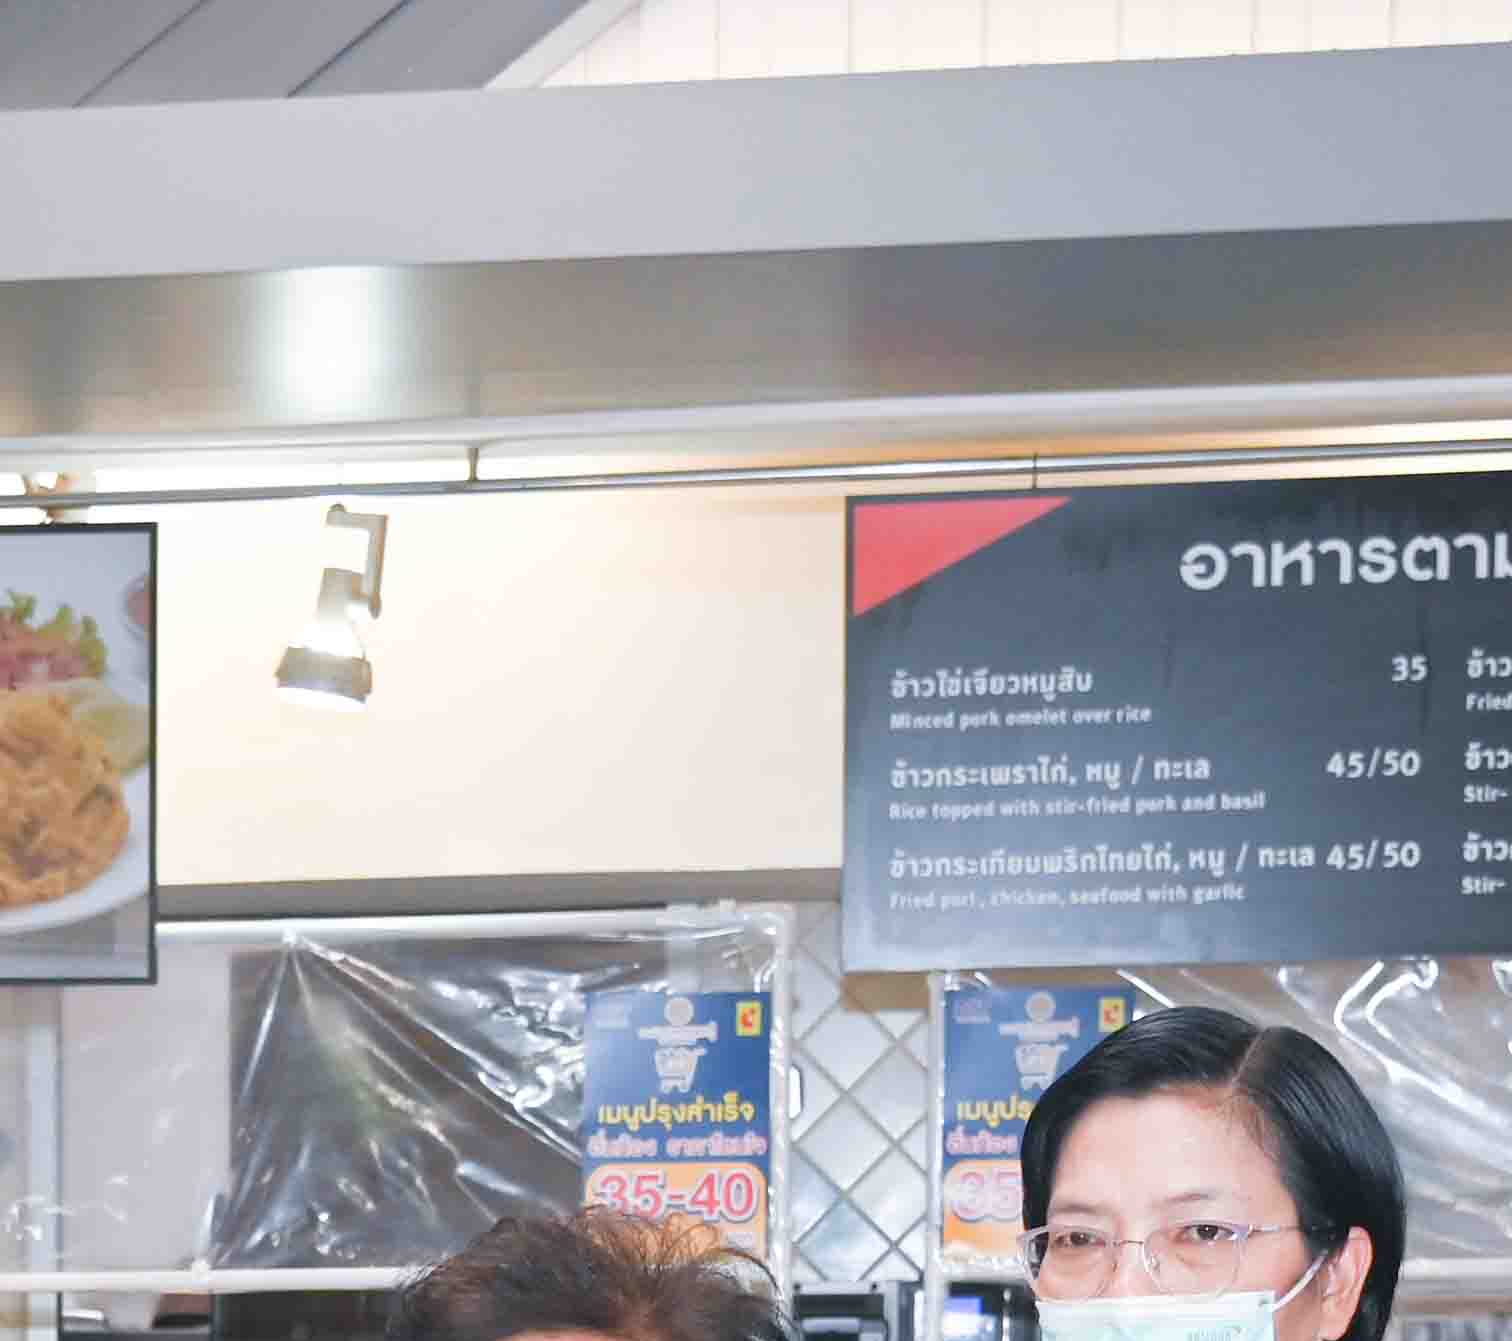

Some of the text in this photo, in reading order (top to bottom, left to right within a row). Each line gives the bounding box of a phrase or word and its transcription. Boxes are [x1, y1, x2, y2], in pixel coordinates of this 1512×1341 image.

[1391, 656, 1427, 682] 35
[889, 712, 954, 730] Minced
[1073, 709, 1111, 725] over
[1116, 706, 1151, 723] rice
[1086, 760, 1120, 789] หมู
[1154, 758, 1211, 781] ทะเล
[1326, 749, 1421, 781] 45/50
[888, 803, 927, 821] Rice
[1000, 800, 1040, 817] with
[1181, 794, 1215, 811] and
[1220, 792, 1266, 810] basil
[1189, 847, 1224, 877] หมู
[1258, 845, 1315, 868] ทะเล
[1327, 841, 1421, 872] 45/50
[1147, 886, 1188, 902] with
